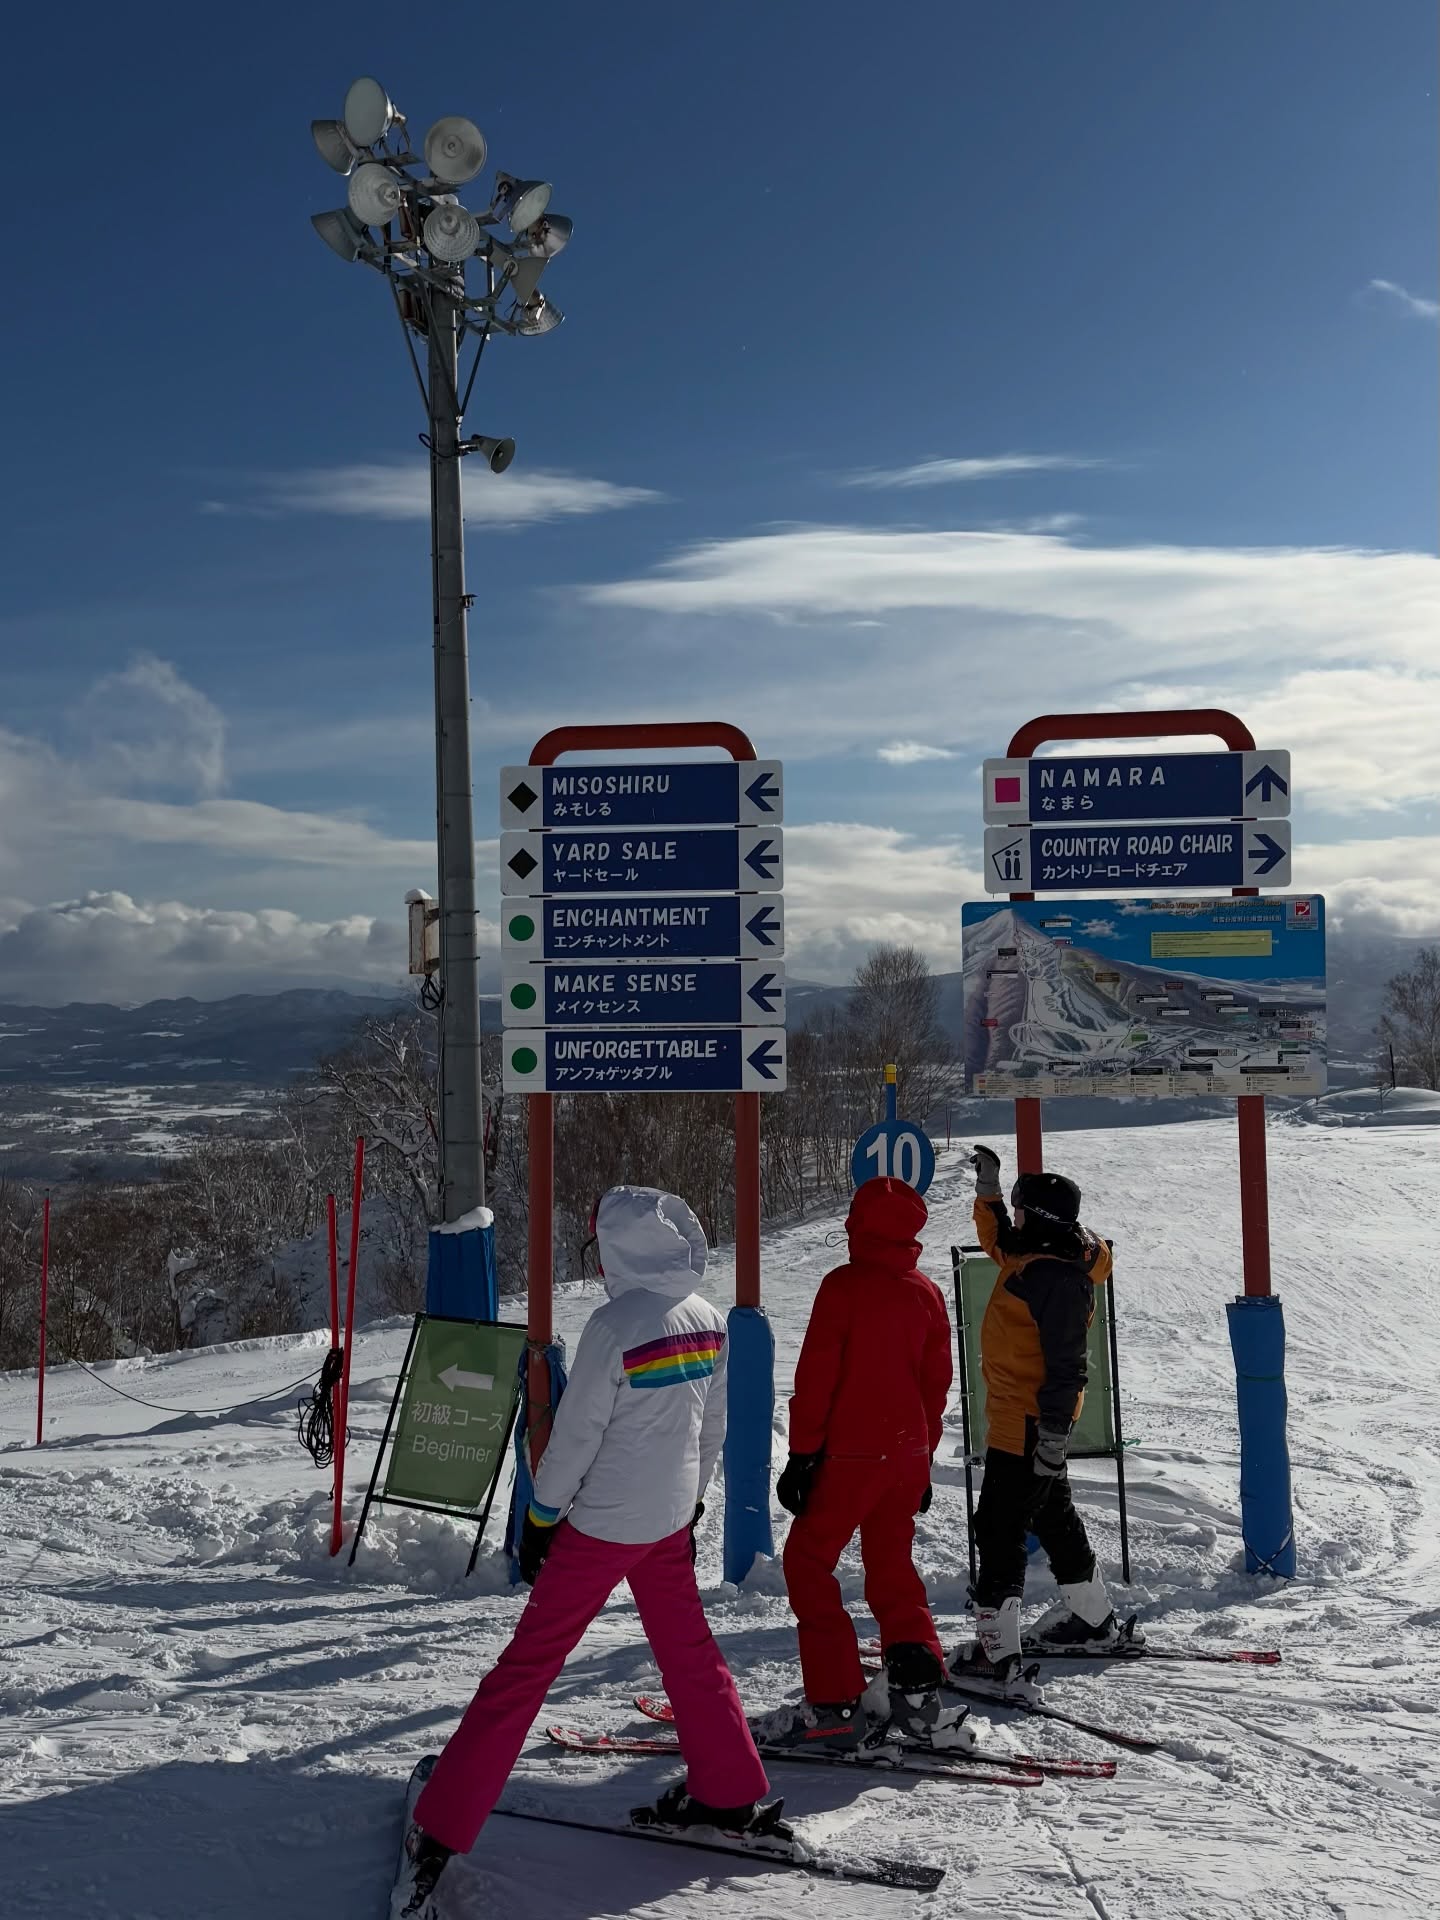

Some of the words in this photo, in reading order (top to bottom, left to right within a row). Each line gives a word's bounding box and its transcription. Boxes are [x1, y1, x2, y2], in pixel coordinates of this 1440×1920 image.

[552, 775, 670, 796] MISOSHIRU
[1040, 766, 1166, 788] NAMARA
[553, 801, 612, 817] みそしる
[1041, 795, 1094, 811] なまら
[552, 843, 610, 861] YARD
[621, 841, 677, 860] SALE
[1041, 836, 1121, 857] COUNTRY
[1127, 836, 1174, 856] ROAD
[1179, 834, 1233, 854] CHAIR
[553, 867, 639, 883] ヤードセール
[1042, 862, 1188, 880] カントリーロードチェア
[552, 907, 711, 928] ENCHANTMENT
[554, 933, 670, 949] エンチャントメント
[554, 974, 615, 993] MAKE
[626, 973, 697, 992] SENSE
[555, 999, 641, 1015] メイクセンス
[554, 1039, 718, 1060] UNFORGETTABLE
[555, 1065, 673, 1081] アンフォゲッタブル
[867, 1132, 921, 1189] 10
[411, 1400, 504, 1433] 初級コース
[412, 1435, 492, 1463] Beginner
